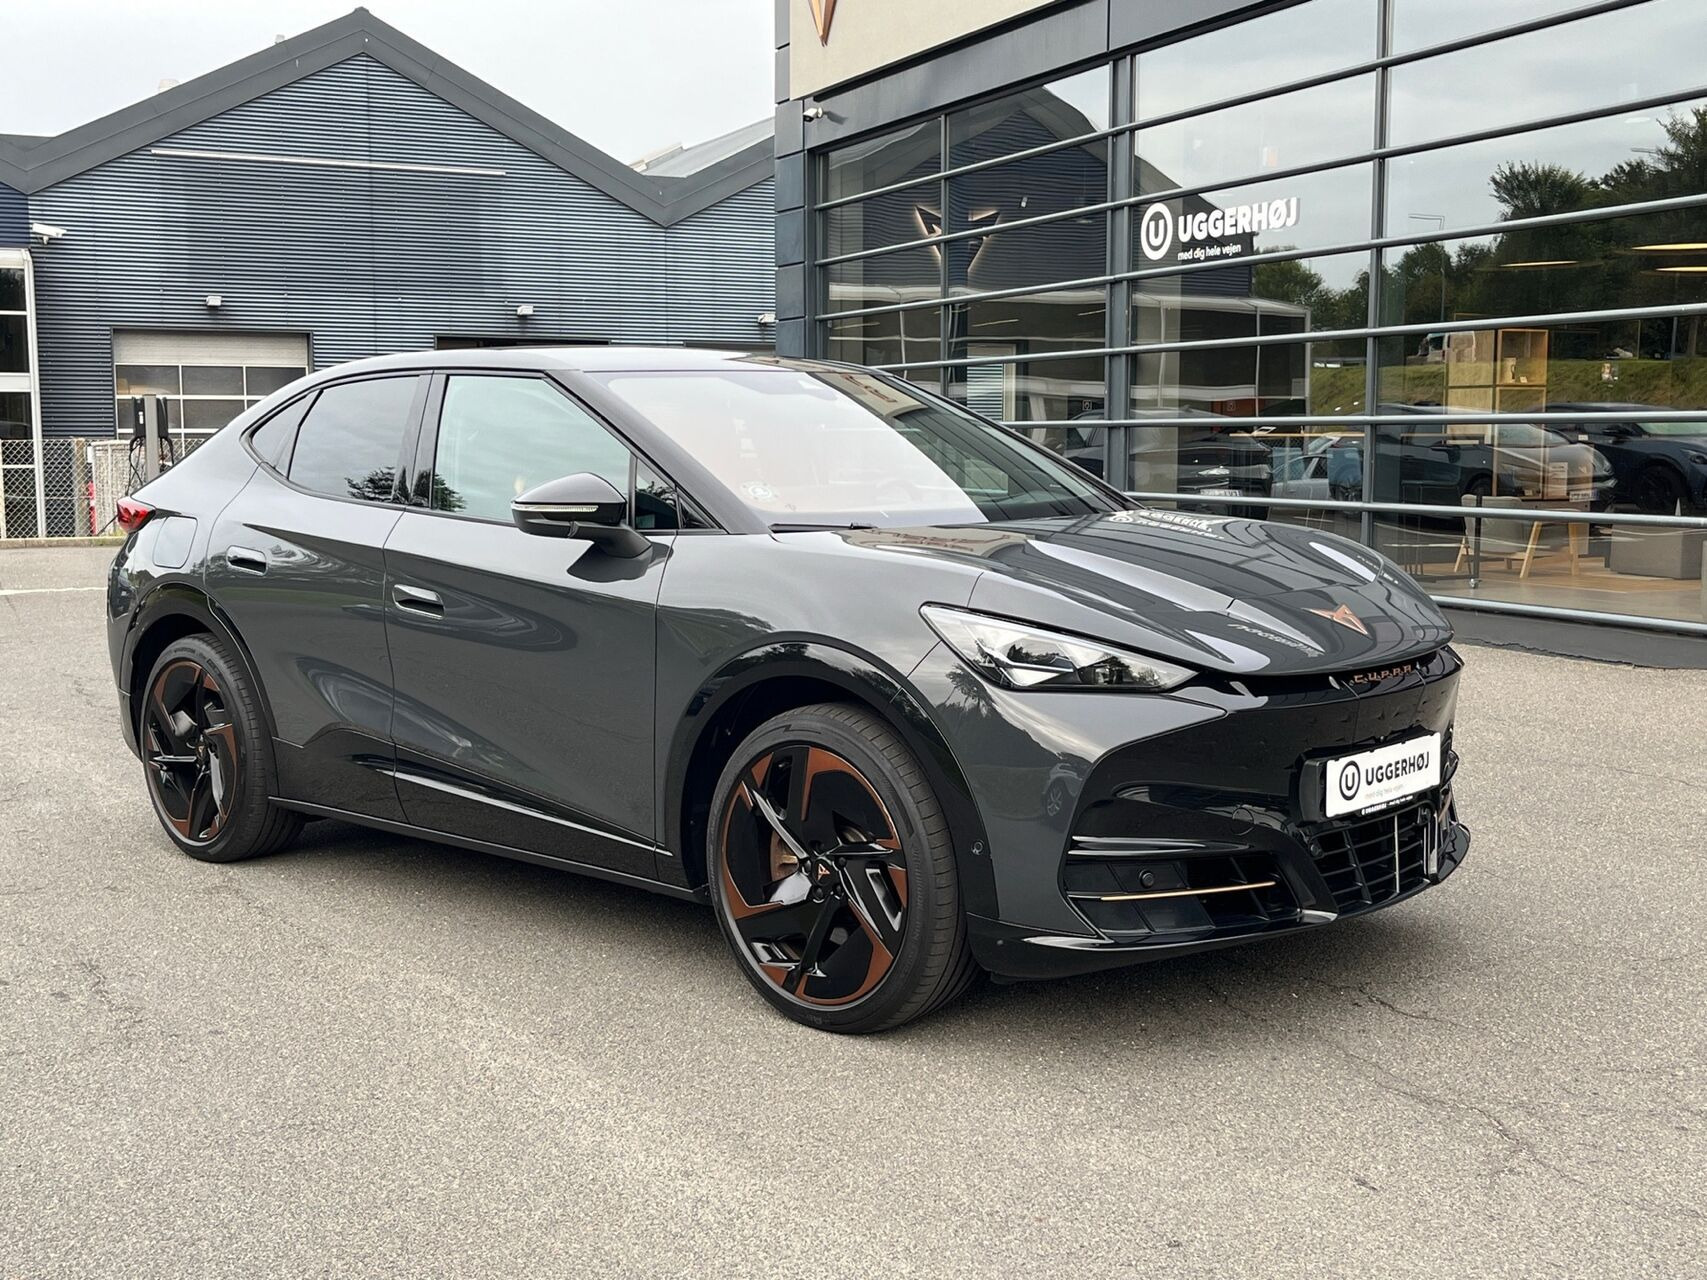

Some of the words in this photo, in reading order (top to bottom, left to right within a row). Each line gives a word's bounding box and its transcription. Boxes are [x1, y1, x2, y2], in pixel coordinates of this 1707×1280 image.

[1177, 196, 1298, 243] UGGERHØJ
[1177, 247, 1193, 261] med
[1193, 247, 1205, 261] dig
[1221, 242, 1242, 257] vejen
[1353, 664, 1412, 684] CUPRA
[1365, 751, 1430, 786] UGGERHØJ
